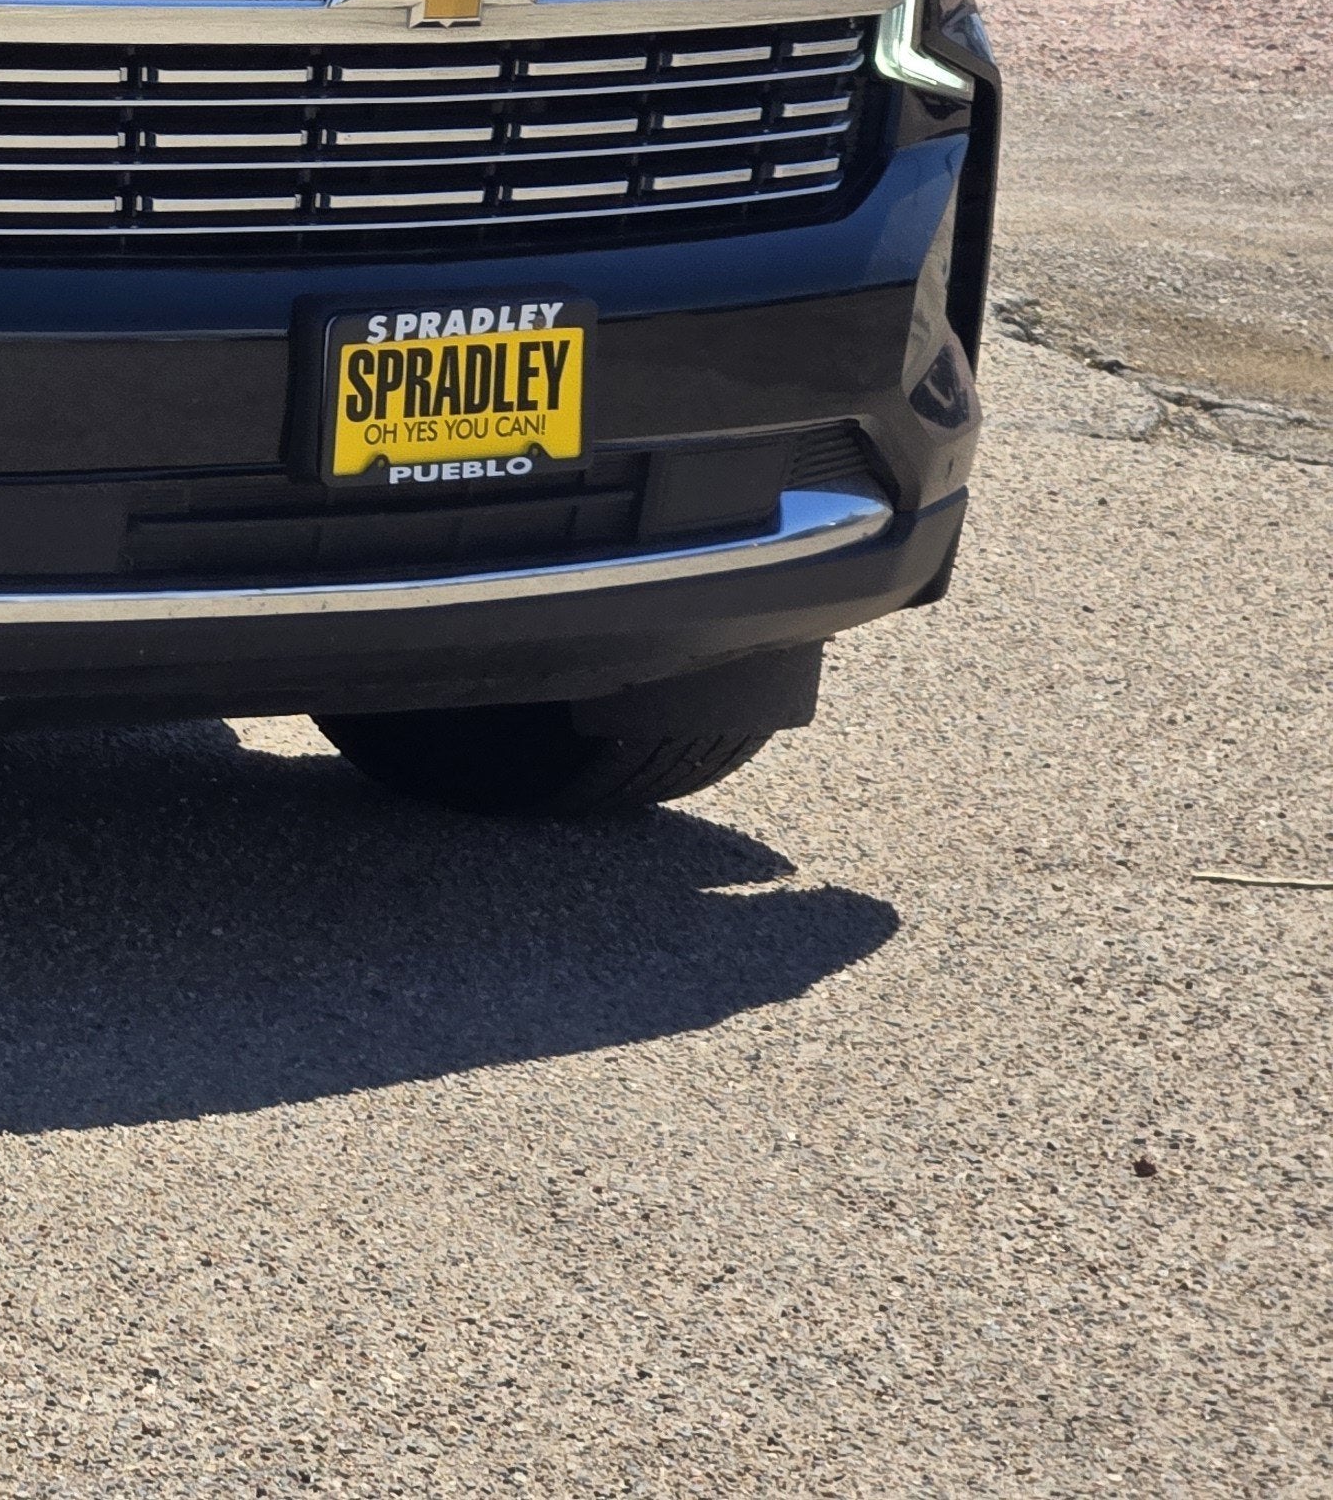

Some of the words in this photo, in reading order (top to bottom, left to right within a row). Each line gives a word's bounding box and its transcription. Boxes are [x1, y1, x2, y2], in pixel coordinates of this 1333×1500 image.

[366, 302, 564, 344] SPRADLEY
[346, 340, 570, 422] SPRADLEY
[364, 423, 398, 445] OH
[404, 420, 438, 443] YES
[444, 416, 489, 440] YOU
[495, 414, 546, 438] CAN!
[389, 456, 533, 485] PUEBLO
